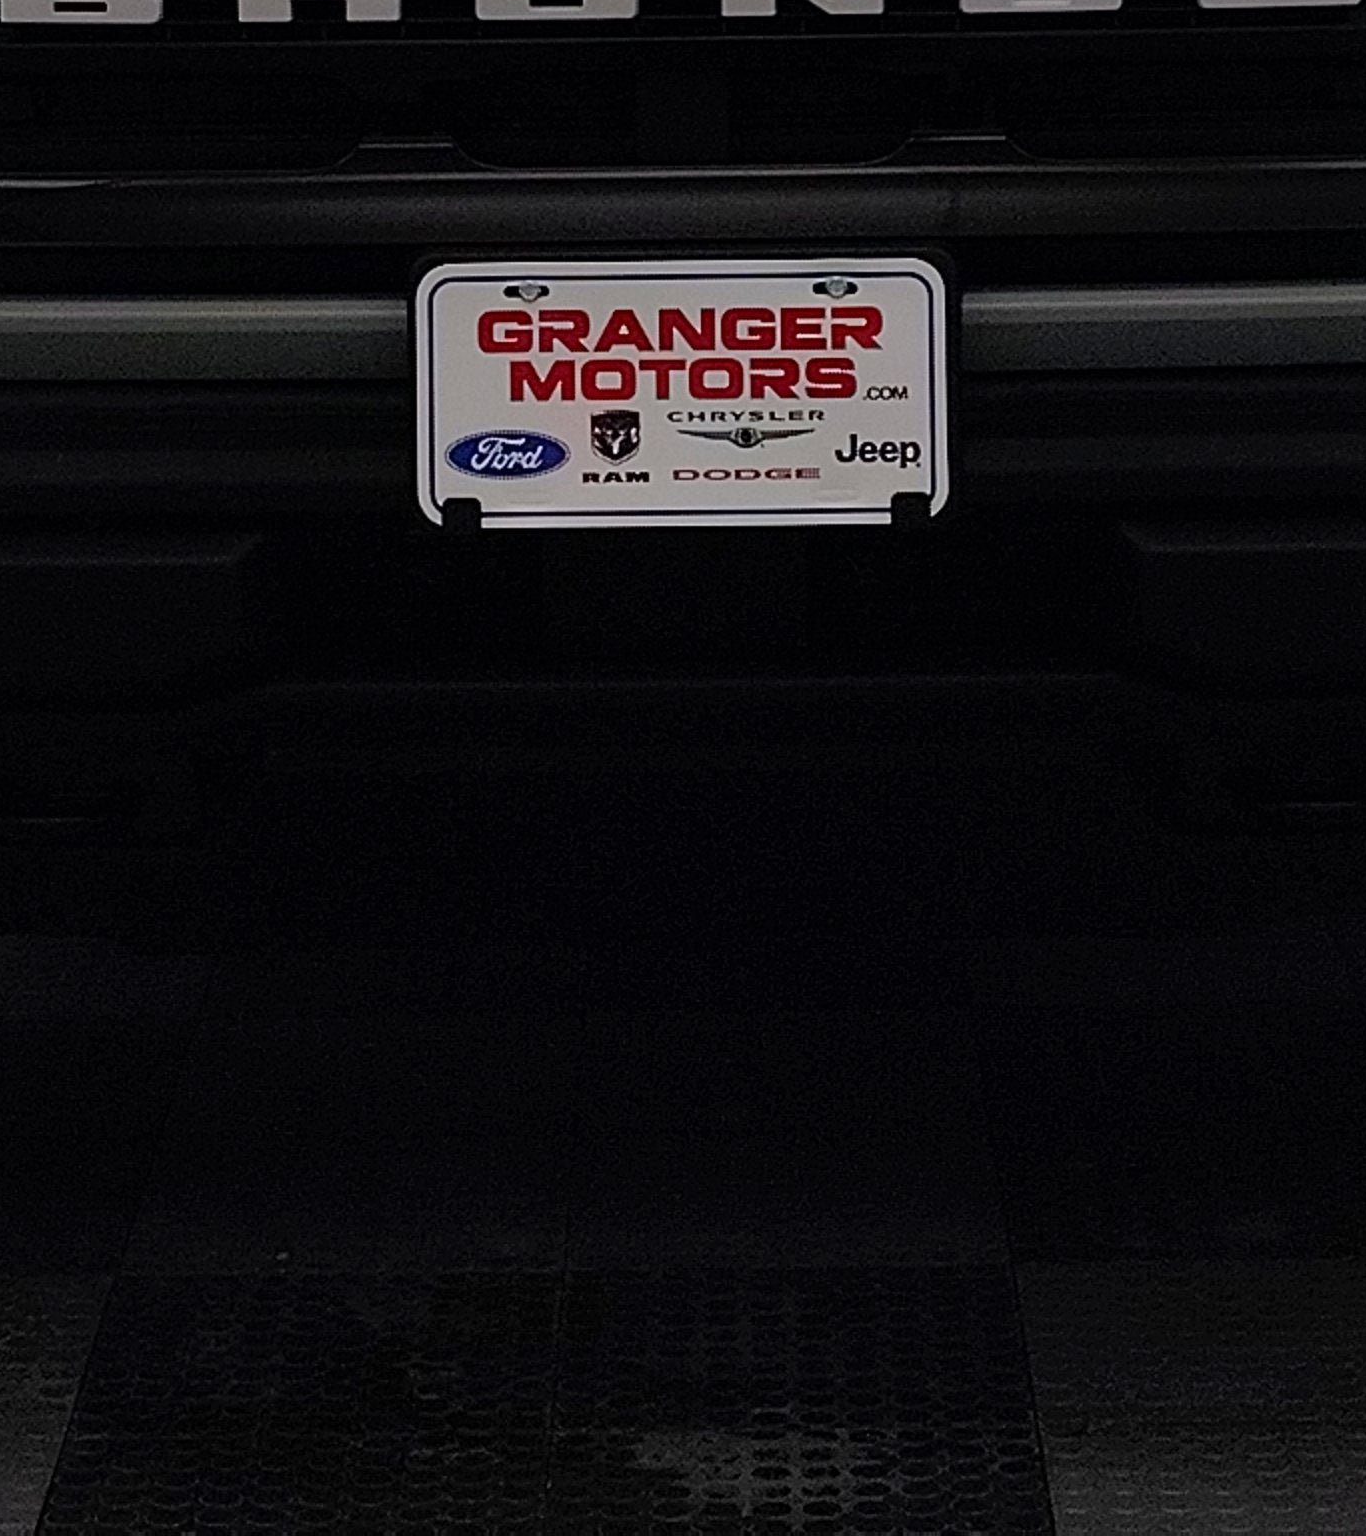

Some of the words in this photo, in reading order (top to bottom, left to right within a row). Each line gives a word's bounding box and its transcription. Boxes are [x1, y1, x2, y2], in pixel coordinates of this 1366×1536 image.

[477, 306, 883, 354] GRANGER
[509, 357, 857, 402] MOTORS
[666, 410, 826, 423] CHRYSLER
[470, 436, 544, 471] Ford
[834, 434, 922, 469] Jeep
[581, 470, 651, 484] RAM
[671, 467, 823, 482] DODGE
